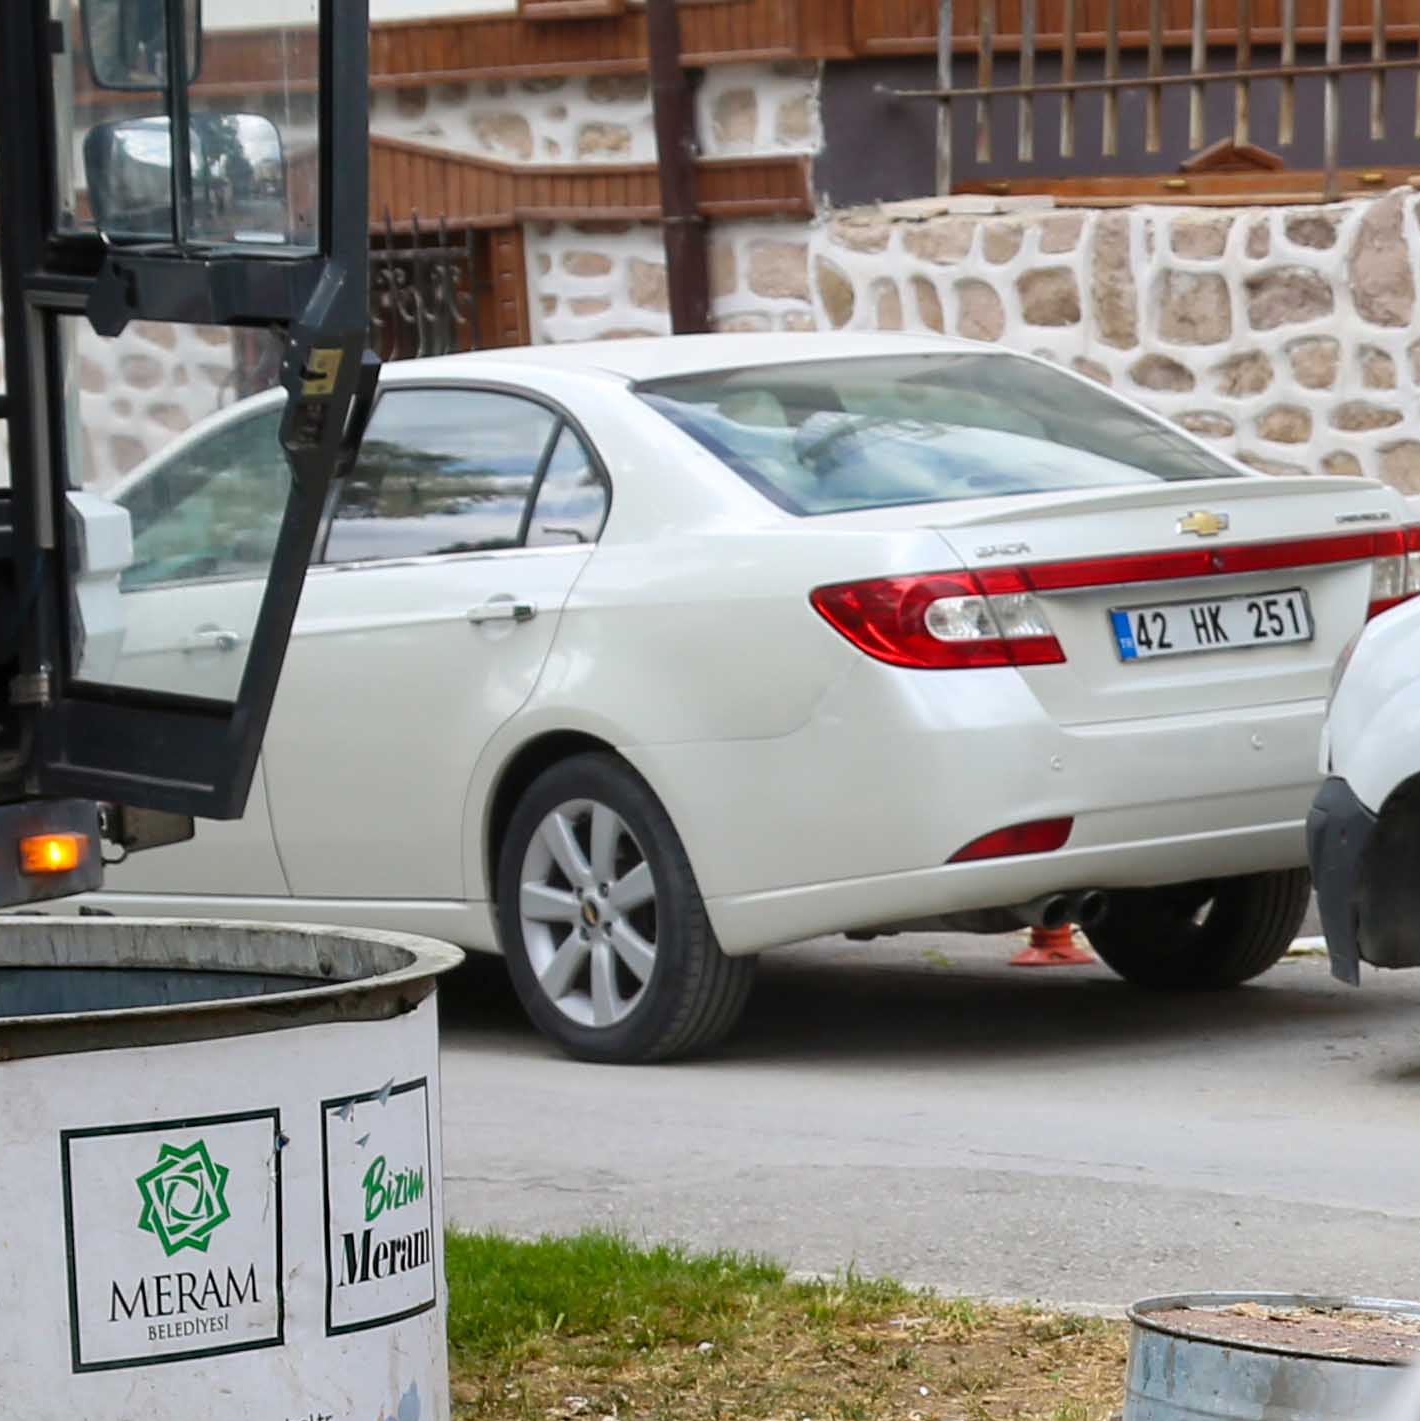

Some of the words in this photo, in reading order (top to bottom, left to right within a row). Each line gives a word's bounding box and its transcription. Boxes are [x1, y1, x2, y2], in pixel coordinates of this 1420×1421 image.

[1137, 612, 1172, 650] 42
[1191, 605, 1229, 645] HK
[1248, 598, 1300, 638] 251
[362, 1155, 424, 1222] Bizim
[337, 1227, 430, 1287] Meram
[108, 1262, 261, 1322] MERAM
[148, 1313, 229, 1341] BELEDİYESİ
